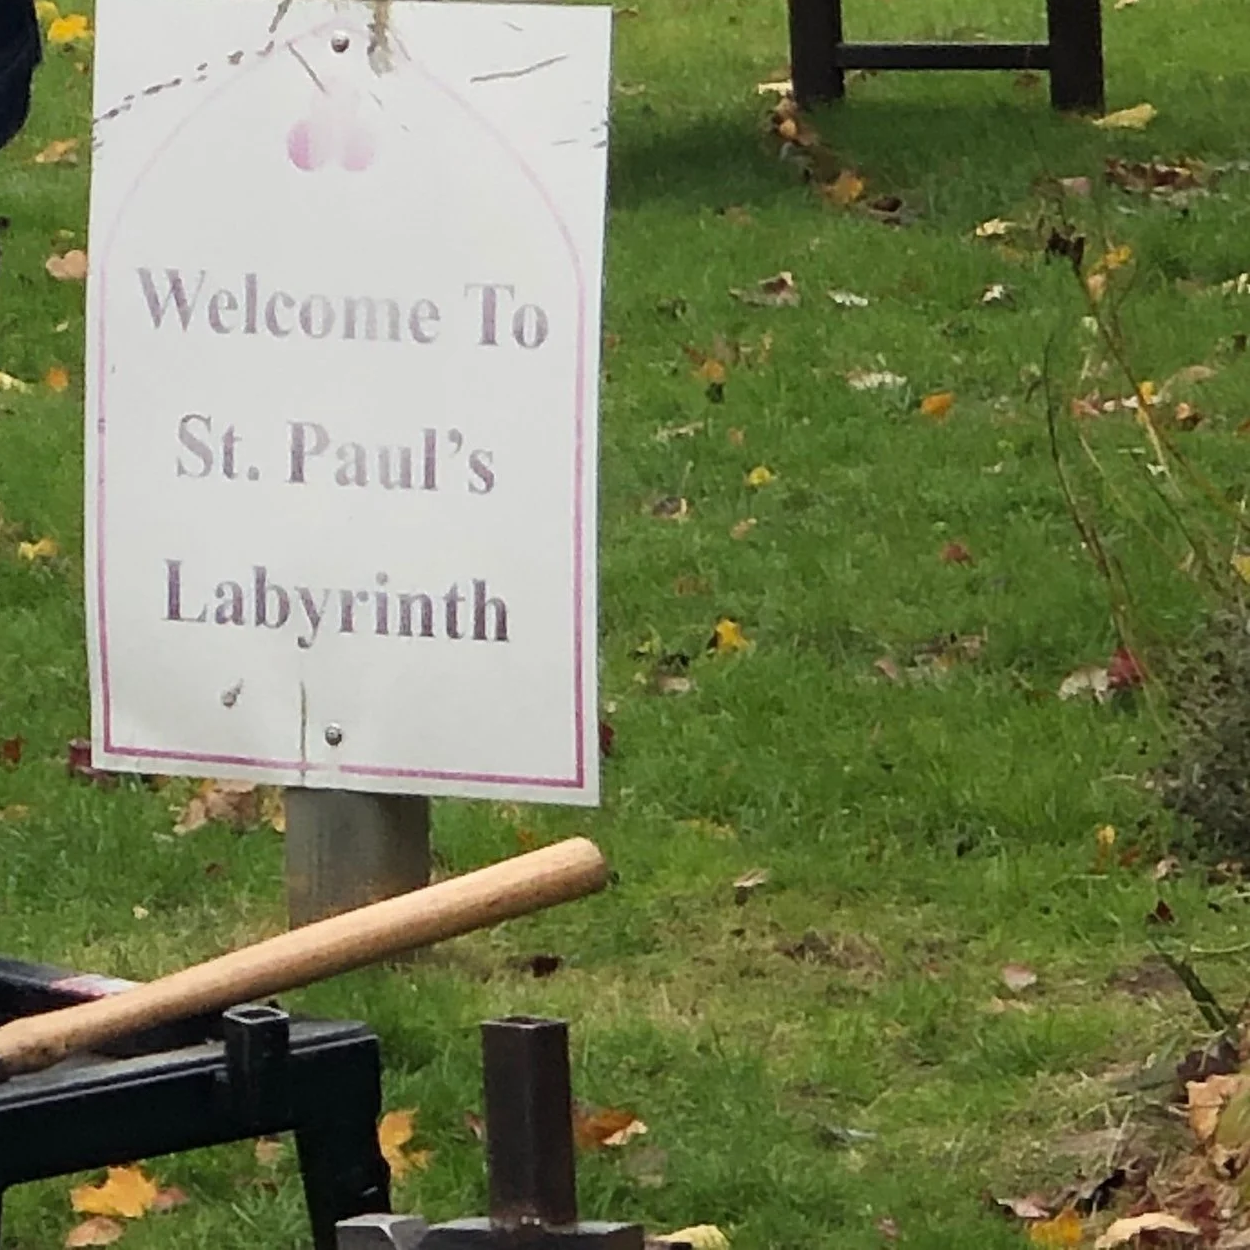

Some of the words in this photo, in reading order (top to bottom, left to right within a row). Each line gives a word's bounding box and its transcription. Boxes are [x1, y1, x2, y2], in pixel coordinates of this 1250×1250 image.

[136, 267, 442, 346] Welcome
[465, 284, 549, 350] To
[176, 414, 260, 482] St.
[285, 421, 496, 496] Paul's
[162, 558, 511, 650] Labyrinth
